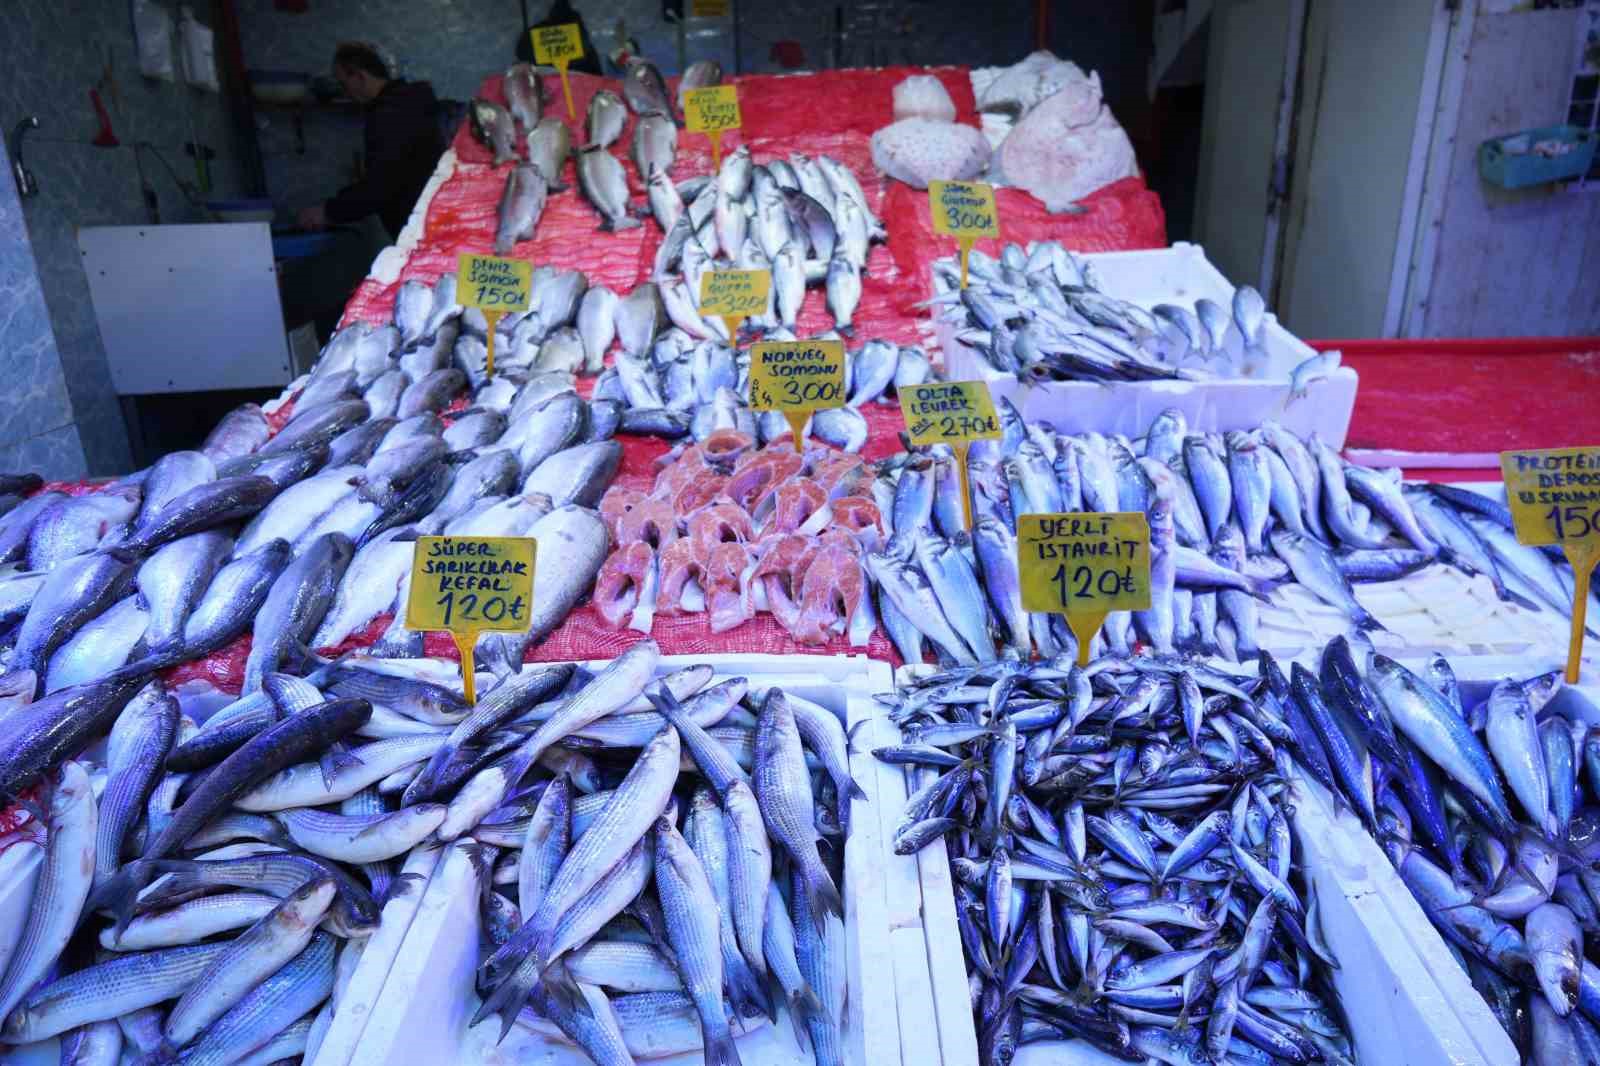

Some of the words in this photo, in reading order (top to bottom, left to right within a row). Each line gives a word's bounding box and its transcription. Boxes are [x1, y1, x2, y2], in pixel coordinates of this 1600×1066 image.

[768, 364, 838, 377] SOMONU
[916, 385, 963, 401] OLTA
[911, 399, 975, 416] LEVREK
[428, 538, 496, 557] SÜPER
[439, 575, 513, 593] KEFAL
